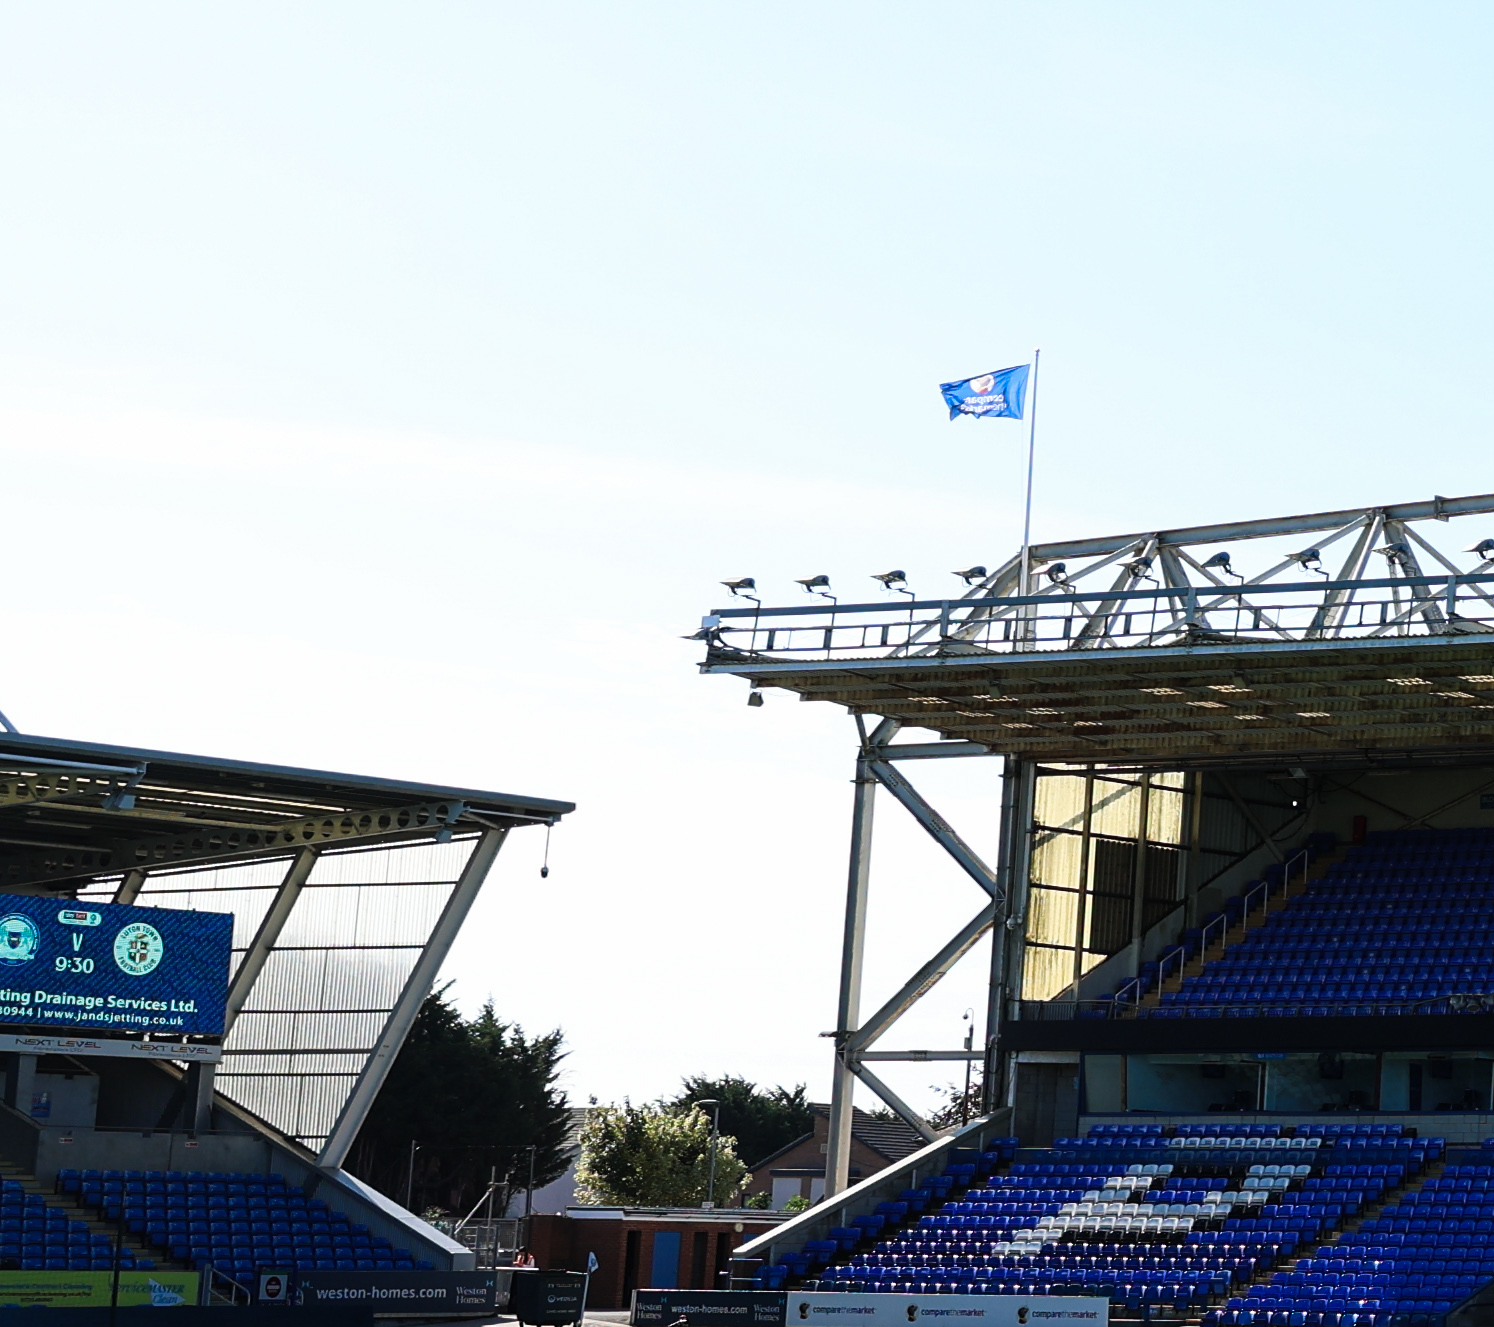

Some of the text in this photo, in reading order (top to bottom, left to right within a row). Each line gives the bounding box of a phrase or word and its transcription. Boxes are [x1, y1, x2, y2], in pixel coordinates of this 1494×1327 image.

[73, 932, 83, 951] V
[55, 956, 95, 974] 9:30
[35, 991, 104, 1009] Drainage
[107, 995, 168, 1011] Services
[171, 999, 198, 1013] Ltd.
[44, 1009, 184, 1026] www.jandsjetting.co.uk
[15, 1038, 102, 1049] NEXT LEVEL
[131, 1043, 213, 1055] NEXT LEVEL
[317, 1286, 447, 1300] weston-homes.com
[456, 1286, 487, 1295] Weston
[456, 1295, 486, 1304] Homes
[636, 1302, 662, 1312] Weston
[671, 1305, 748, 1314] weston-homes.com
[754, 1304, 780, 1313] Weston
[813, 1306, 876, 1315] comparethemarket
[637, 1312, 662, 1320] Homes
[755, 1313, 780, 1322] Homes
[921, 1308, 985, 1318] comparethemarket
[1032, 1310, 1097, 1320] comparethemarket
